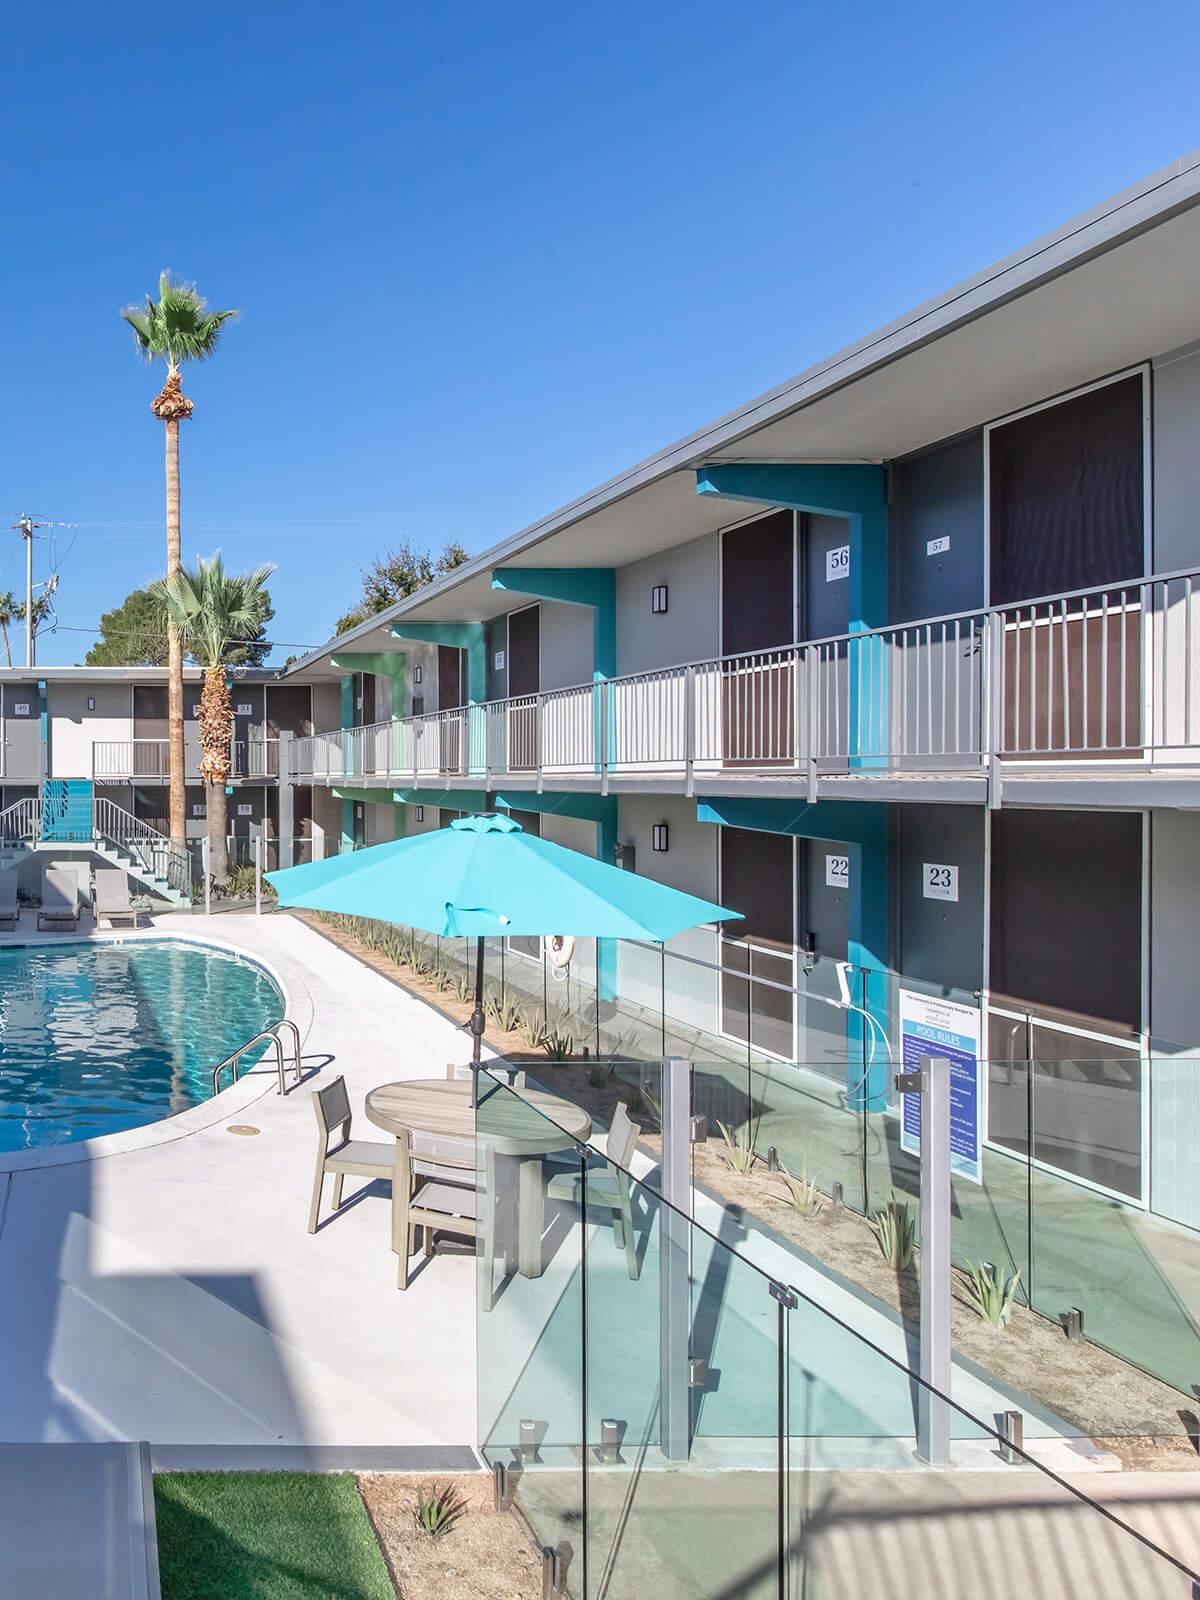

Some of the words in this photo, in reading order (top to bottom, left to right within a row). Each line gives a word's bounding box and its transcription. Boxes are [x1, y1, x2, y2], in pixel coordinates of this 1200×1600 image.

[932, 540, 943, 551] 57
[831, 550, 849, 568] 56
[831, 859, 848, 875] 22
[930, 868, 951, 887] 23
[916, 1025, 937, 1039] POOL
[938, 1031, 960, 1046] RULES
